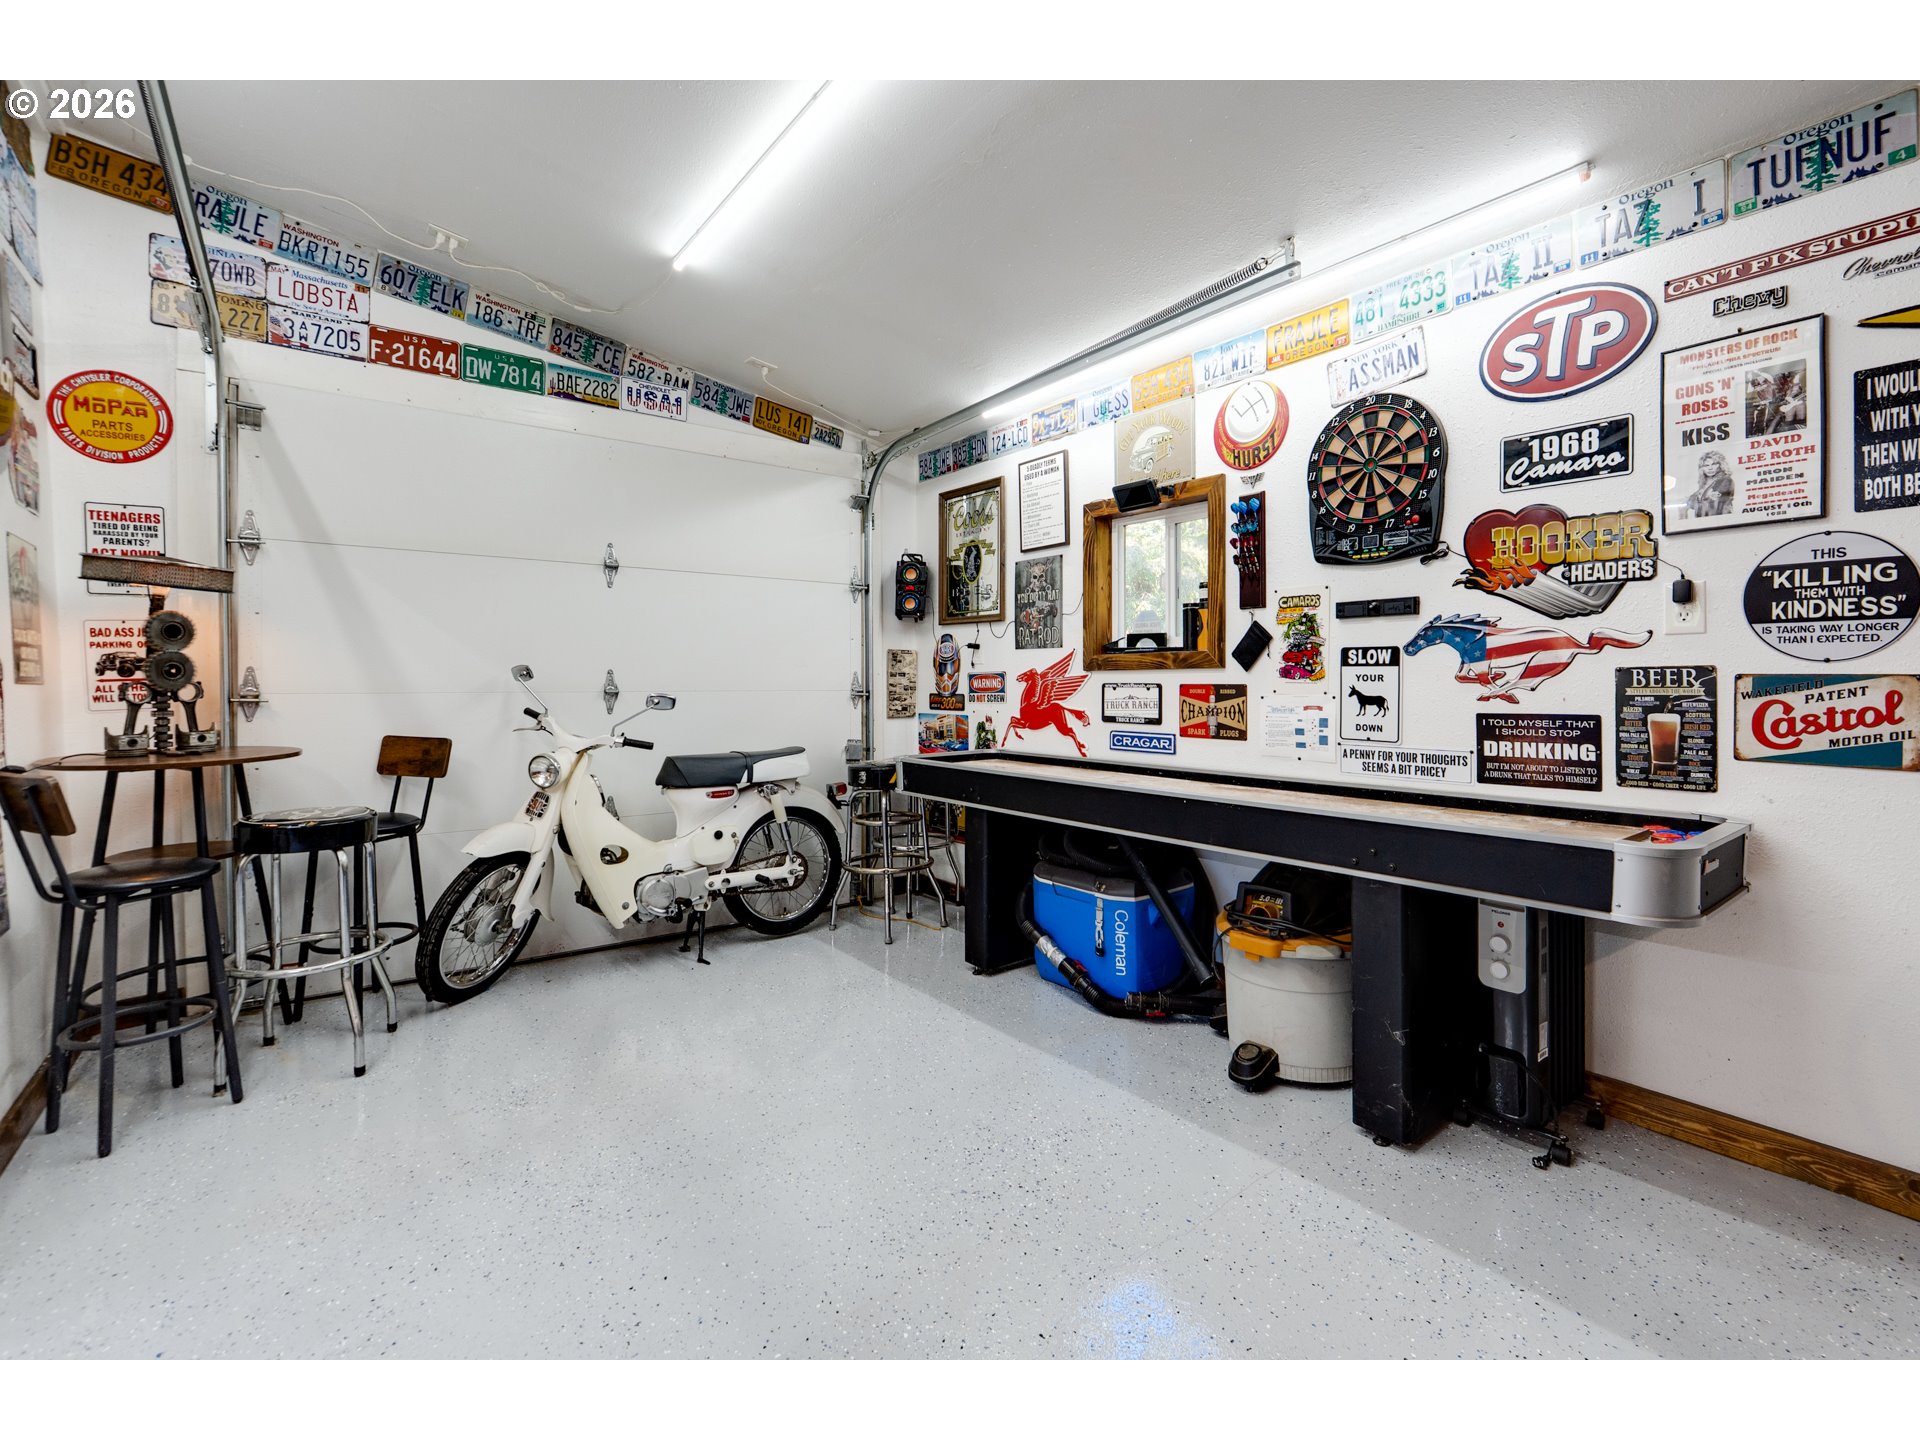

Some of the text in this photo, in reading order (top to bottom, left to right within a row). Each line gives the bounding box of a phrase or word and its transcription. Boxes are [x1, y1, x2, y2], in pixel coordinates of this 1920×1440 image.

[1784, 114, 1853, 145] Oregon
[1747, 111, 1897, 196] TUFNUF
[53, 138, 169, 196] BSH 434
[79, 172, 144, 200] OREGON
[206, 186, 248, 206] Oregon
[1619, 179, 1674, 205] Oregon
[192, 189, 269, 238] RAJLE
[1595, 199, 1650, 248] TAZ
[283, 223, 340, 248] WASHINGTON
[277, 230, 370, 279] BKR1155
[1667, 212, 1920, 297] CAN'T FIX STUPI
[292, 269, 348, 289] Massachusetts
[408, 264, 442, 281] Oregon
[278, 276, 358, 314] LOBSTA
[380, 264, 467, 311] 607 ELK
[1400, 271, 1446, 309] 4333
[475, 294, 521, 315] WASHINGTON
[1713, 284, 1788, 316] Chevy
[292, 310, 342, 325] MARYLAND
[1274, 308, 1338, 353] FRAJLE
[1500, 294, 1628, 386] STP
[553, 327, 622, 369] 845 FCE
[1286, 341, 1328, 360] OREGON
[1679, 328, 1798, 365] MONSTERS OF ROCK
[631, 353, 669, 371] WASHINGTON
[1349, 342, 1419, 391] ASSMAN
[72, 372, 160, 408] CHRYSLER CORPORATION
[556, 374, 618, 400] BAE2282
[694, 382, 719, 404] 584
[1676, 381, 1714, 400] GUNS
[1866, 378, 1872, 400] I
[1365, 395, 1376, 406] 20
[1681, 396, 1728, 416] ROSES
[92, 419, 133, 432] PARTS
[758, 402, 808, 434] LUS 141
[1871, 405, 1909, 433] WITH
[79, 429, 146, 442] ACCESSORIES
[767, 423, 798, 439] OREGON
[1682, 423, 1730, 447] KISS
[59, 426, 164, 461] PARTS DIVISION PRODUCTS
[1232, 428, 1277, 467] HURST
[1528, 427, 1600, 464] 1968
[1750, 433, 1802, 450] DAVID
[1738, 444, 1816, 465] LEE ROTH
[1862, 441, 1899, 468] THEN
[1427, 469, 1438, 480] 10
[1505, 450, 1625, 486] Camaro
[1757, 466, 1793, 477] IRON
[1746, 472, 1804, 486] MAIDEN
[1864, 475, 1901, 501] BOTH
[88, 509, 161, 524] TEENAGERS
[952, 504, 994, 531] Coors
[1319, 505, 1326, 514] 16
[1742, 503, 1783, 514] AUGUST
[92, 522, 158, 532] TIRED OF BEING
[1385, 519, 1395, 529] 17
[102, 537, 151, 547] PARENTS?
[1490, 513, 1654, 570] HOOKER
[1811, 547, 1847, 560] THIS
[1570, 560, 1654, 583] HEADERS
[1280, 595, 1320, 608] CAMAROS
[1795, 585, 1866, 599] THEM WITH
[90, 628, 134, 638] BAD ASS
[1038, 626, 1059, 647] ROD
[1762, 621, 1900, 635] IS TAKING WAY LONGER
[1777, 632, 1882, 644] THAN I EXPECTED.
[1348, 649, 1391, 664] SLOW
[973, 679, 1002, 689] WARNING
[1355, 674, 1384, 682] YOUR
[1630, 668, 1703, 688] BEER
[92, 695, 115, 703] WILL
[95, 685, 114, 693] ALL
[969, 694, 976, 703] DO
[976, 694, 986, 703] NOT
[987, 694, 1005, 703] SCREW
[1740, 680, 1824, 700] WAKEFIELD
[1804, 685, 1869, 704] PATENT
[1105, 700, 1159, 710] TRUCK RANCH
[1181, 699, 1246, 730] CHAMPION
[1355, 724, 1383, 732] DOWN
[1487, 719, 1516, 727] TOLD
[1518, 719, 1563, 728] MYSELF
[1565, 720, 1596, 728] THAT
[1751, 689, 1905, 750] Castrol
[1114, 736, 1171, 749] CRAGAR
[1187, 728, 1239, 738] SPARK PLUGS
[1501, 728, 1547, 737] SHOULD
[1549, 729, 1581, 737] STOP
[1828, 730, 1917, 748] MOTOR OIL
[1343, 749, 1468, 767] A PENNY FOR YOUR THOUGHTS
[1483, 740, 1597, 762] DRINKING
[1362, 762, 1446, 778] SEEMS A BIT PRICEY
[1486, 762, 1499, 770] BUT
[1510, 763, 1525, 771] NOT
[1525, 764, 1549, 773] ABOUT
[1550, 765, 1559, 773] TO
[1560, 766, 1585, 775] LISTEN
[1586, 767, 1597, 776] TO
[1489, 771, 1598, 784] DRUNK THAT TALKS TO HIMSELF
[1114, 909, 1129, 976] Coleman
